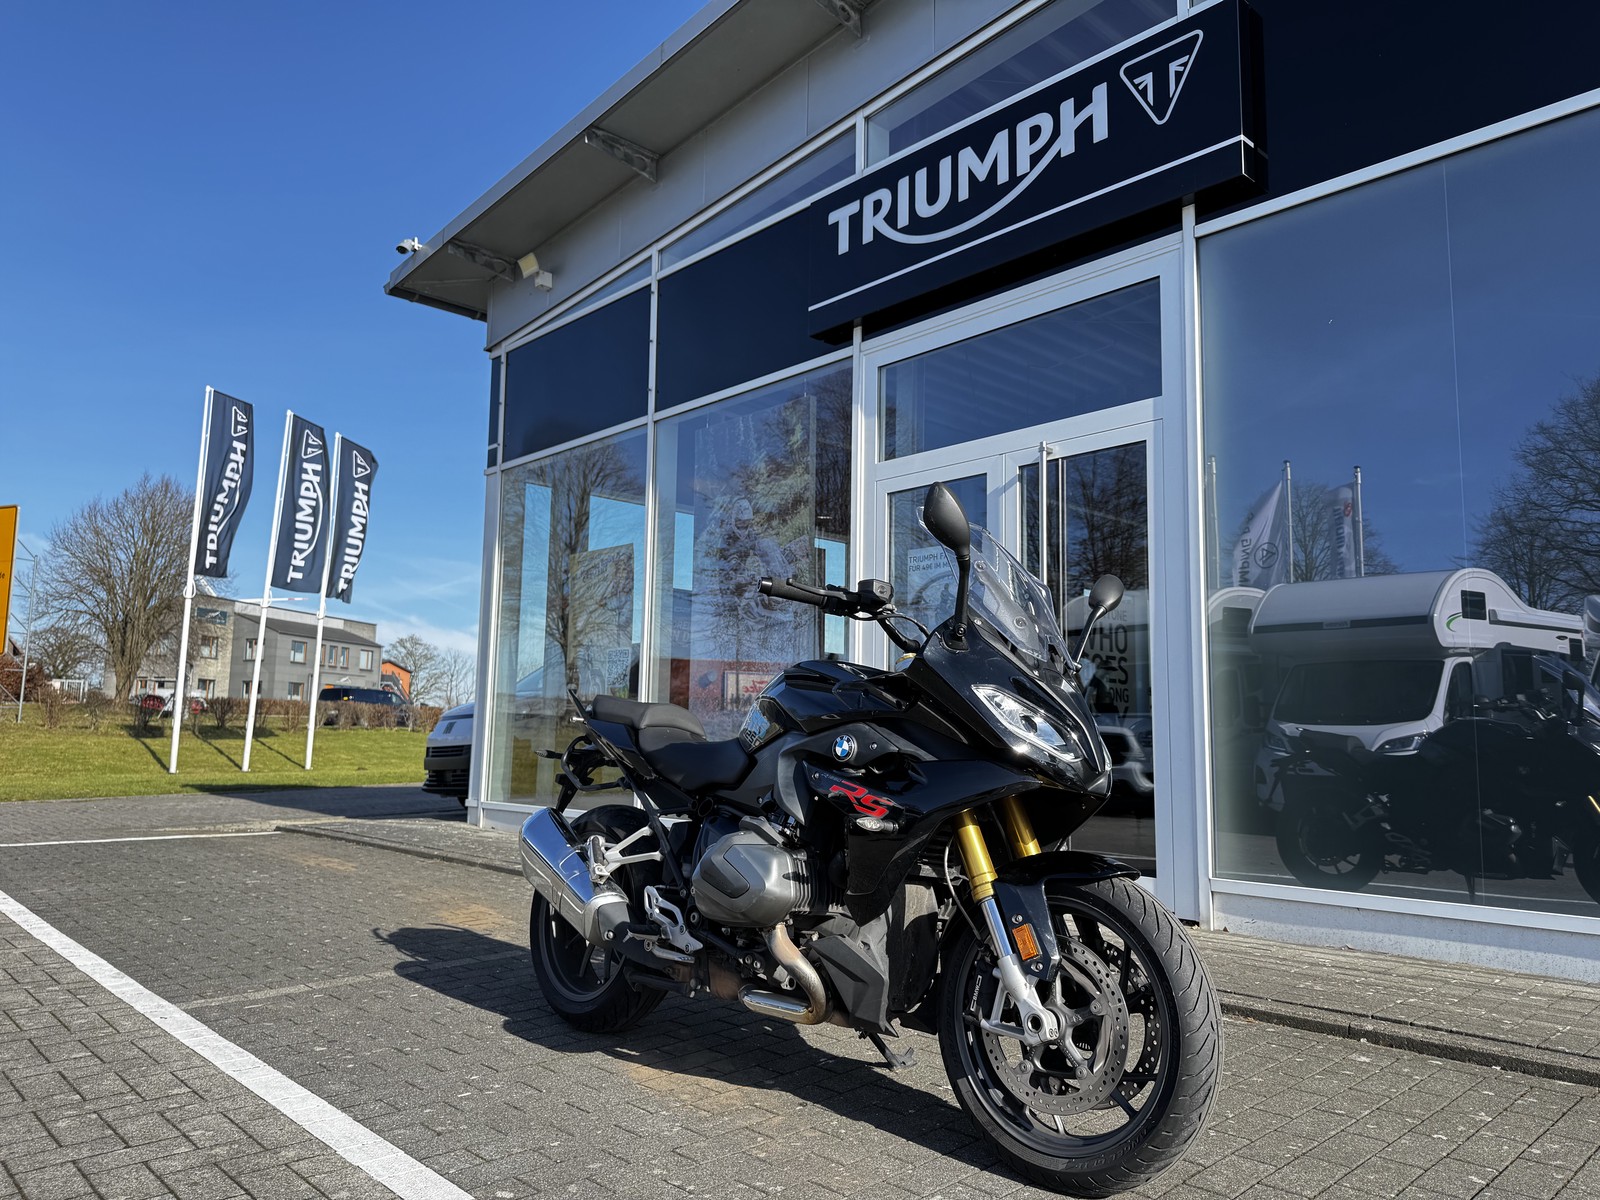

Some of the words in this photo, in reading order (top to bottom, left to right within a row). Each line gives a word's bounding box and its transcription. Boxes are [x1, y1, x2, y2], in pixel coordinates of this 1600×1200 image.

[828, 82, 1108, 256] TRIUMPH
[287, 462, 323, 583] TRIUMPH
[337, 481, 370, 593] TRIUMPH
[909, 553, 938, 564] TRIUMPH
[933, 561, 942, 570] IM
[828, 780, 894, 819] RS
[972, 985, 980, 1001] BMW
